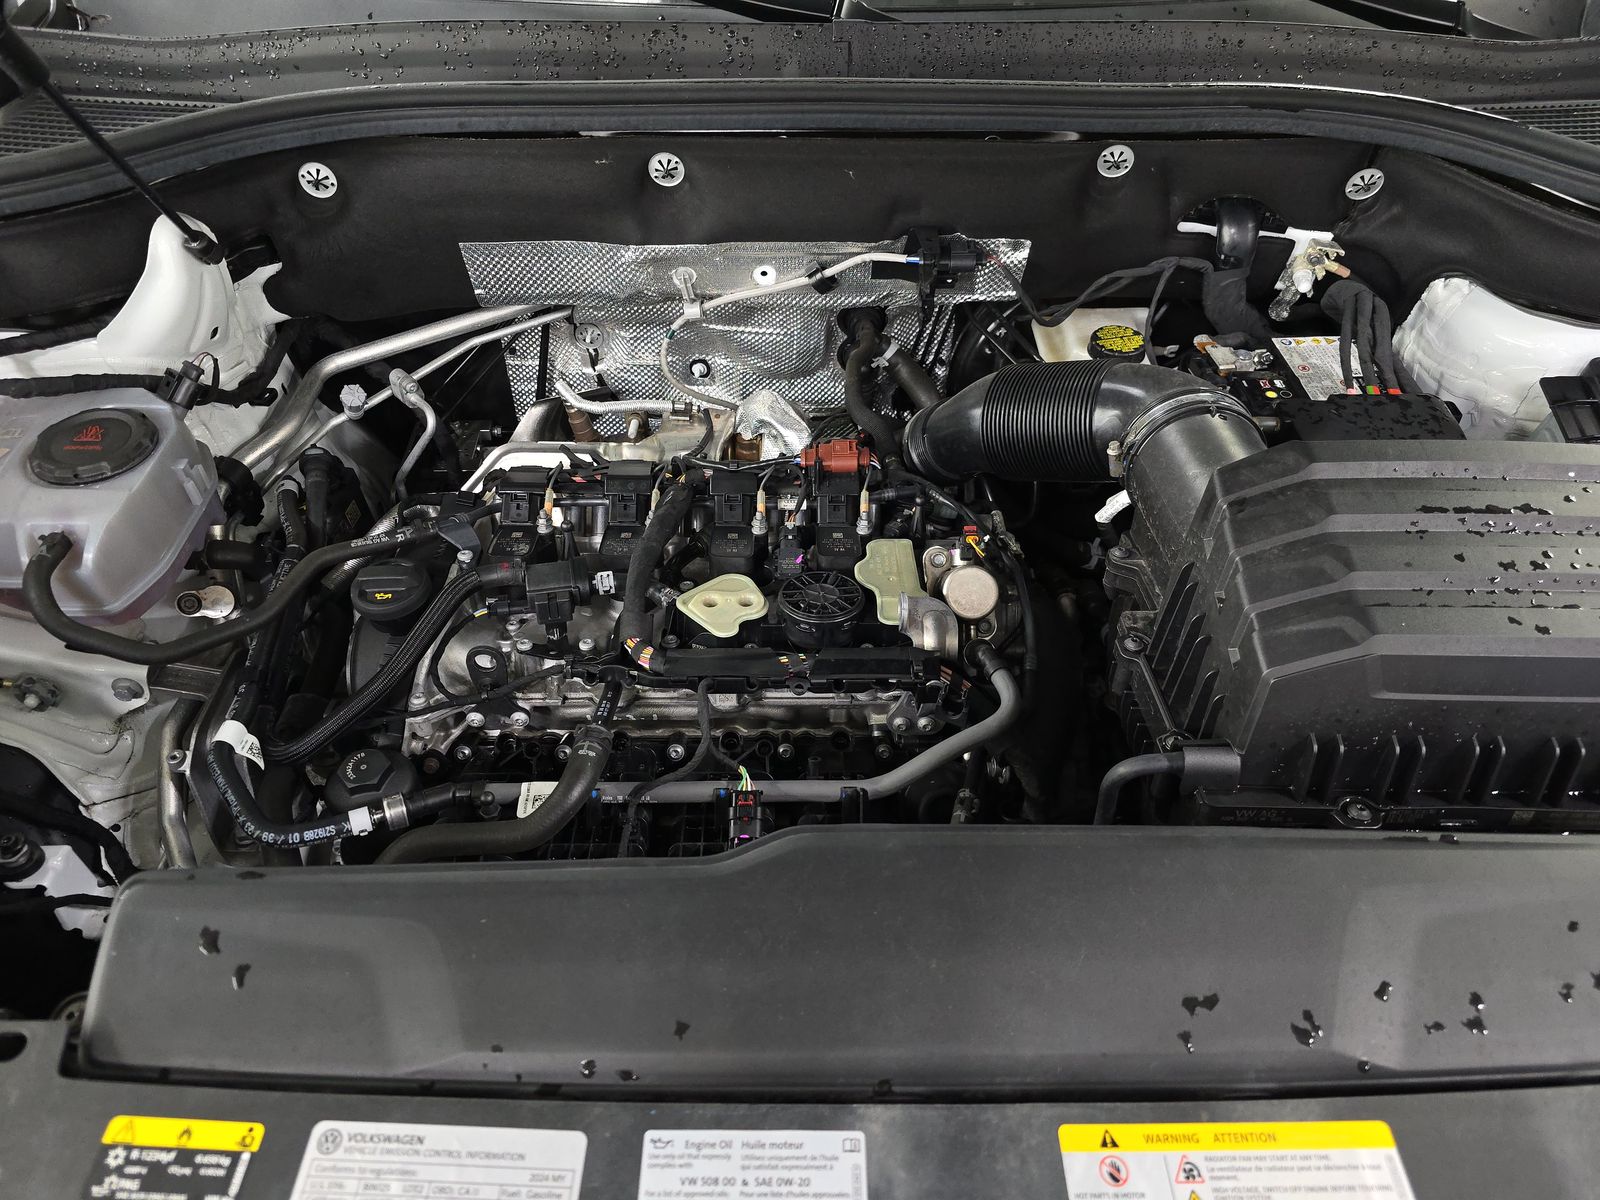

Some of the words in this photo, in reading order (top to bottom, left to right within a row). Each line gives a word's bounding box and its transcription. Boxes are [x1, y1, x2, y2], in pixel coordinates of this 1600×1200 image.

[347, 1132, 426, 1145] VOLKSWAGEN
[1142, 1133, 1200, 1144] WARNING
[1213, 1132, 1277, 1143] ATTENTION
[685, 1140, 717, 1151] Engine
[719, 1139, 733, 1150] Oil
[741, 1140, 766, 1150] Huile
[769, 1140, 804, 1150] moteur
[680, 1176, 699, 1187] VW
[701, 1176, 720, 1187] 508
[721, 1176, 737, 1187] 00
[741, 1178, 749, 1187] &
[754, 1176, 773, 1187] SAE
